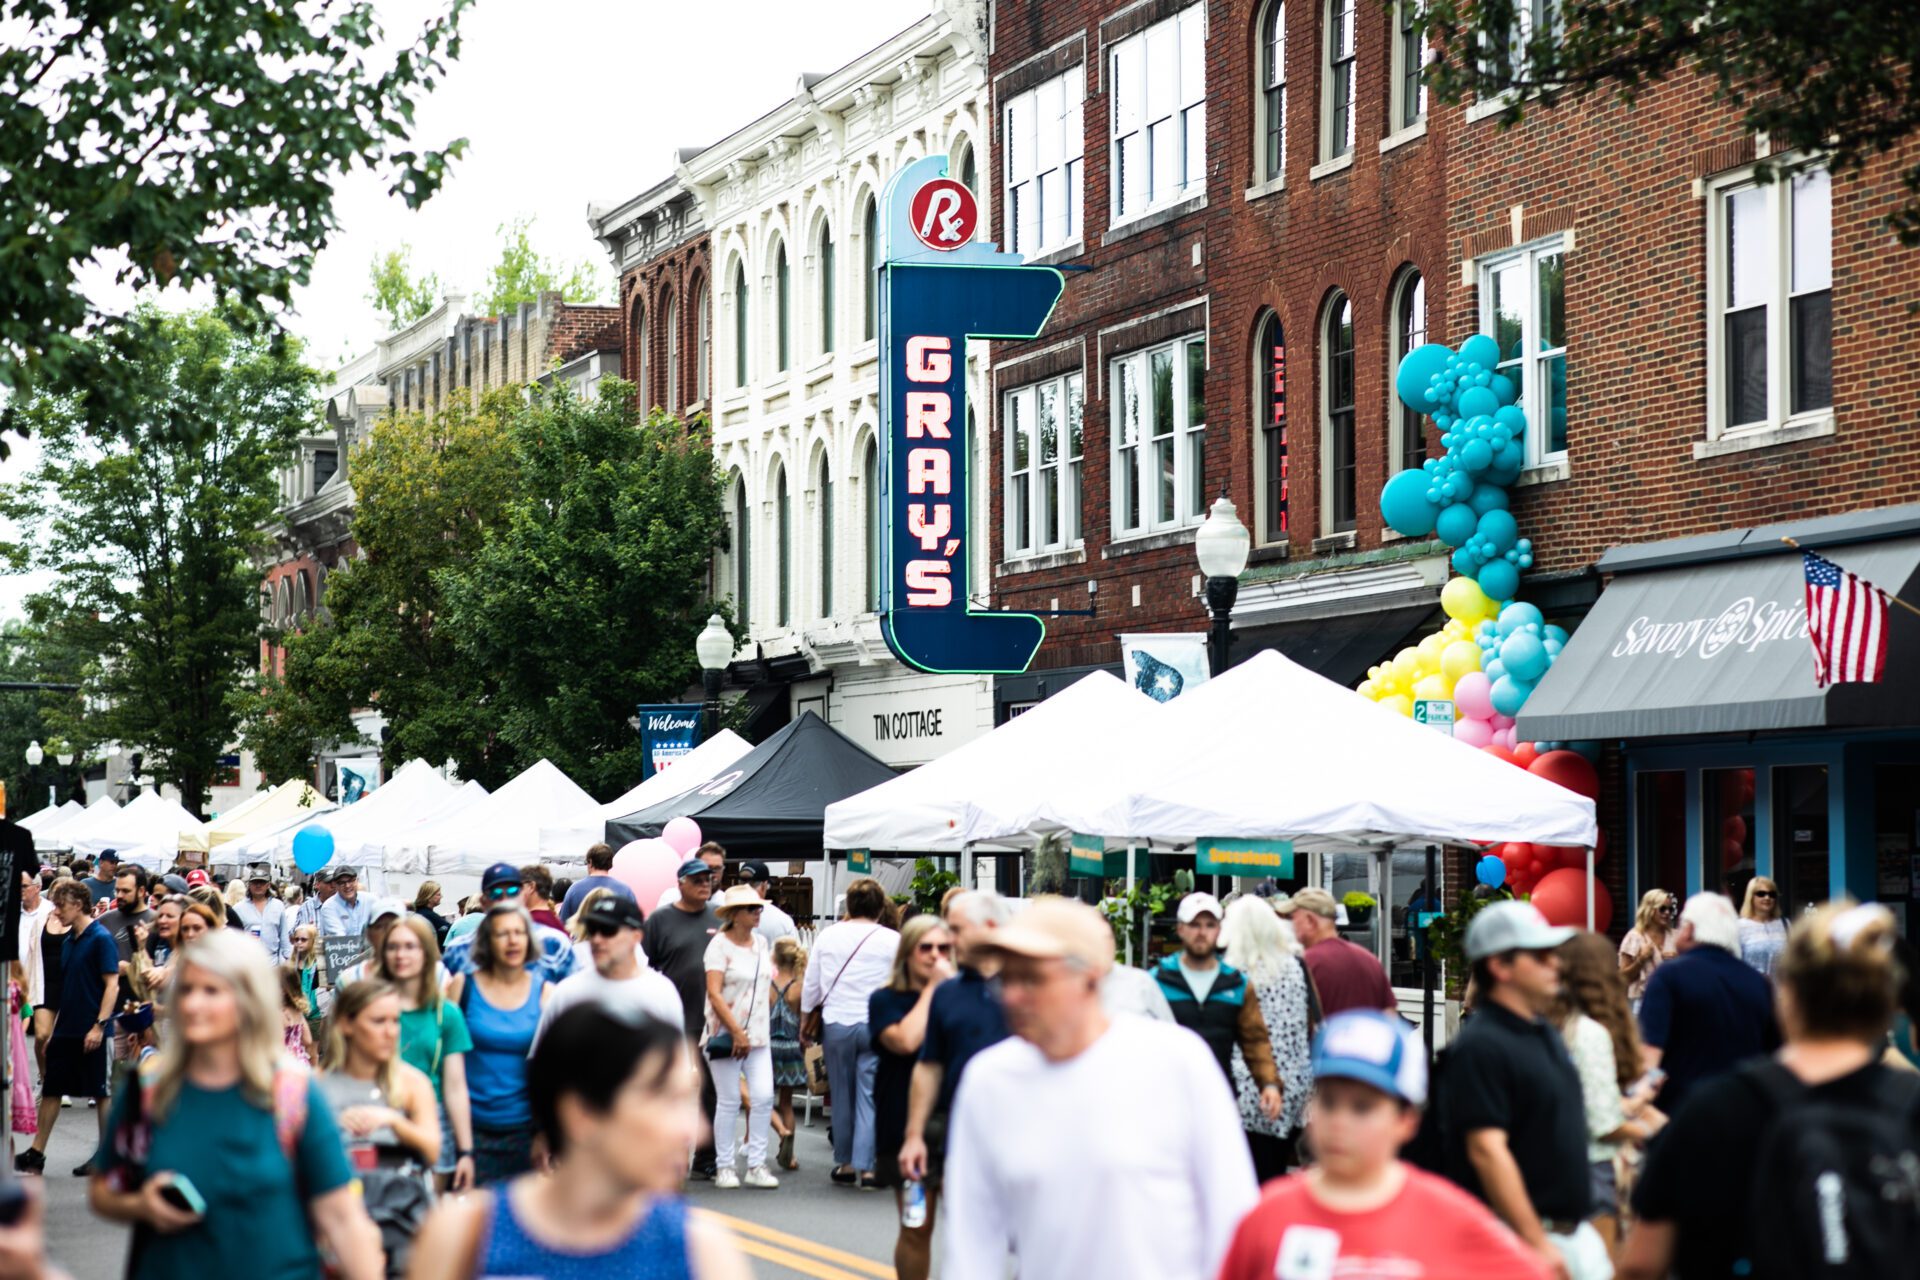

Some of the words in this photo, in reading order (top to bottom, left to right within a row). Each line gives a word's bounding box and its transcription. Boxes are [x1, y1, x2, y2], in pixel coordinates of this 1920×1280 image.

[905, 335, 961, 607] GRAY'S
[1611, 616, 1717, 659] Savory
[648, 713, 696, 731] Welcome
[873, 714, 890, 741] TIN
[892, 708, 942, 739] COTTAGE
[1416, 704, 1426, 721] 2
